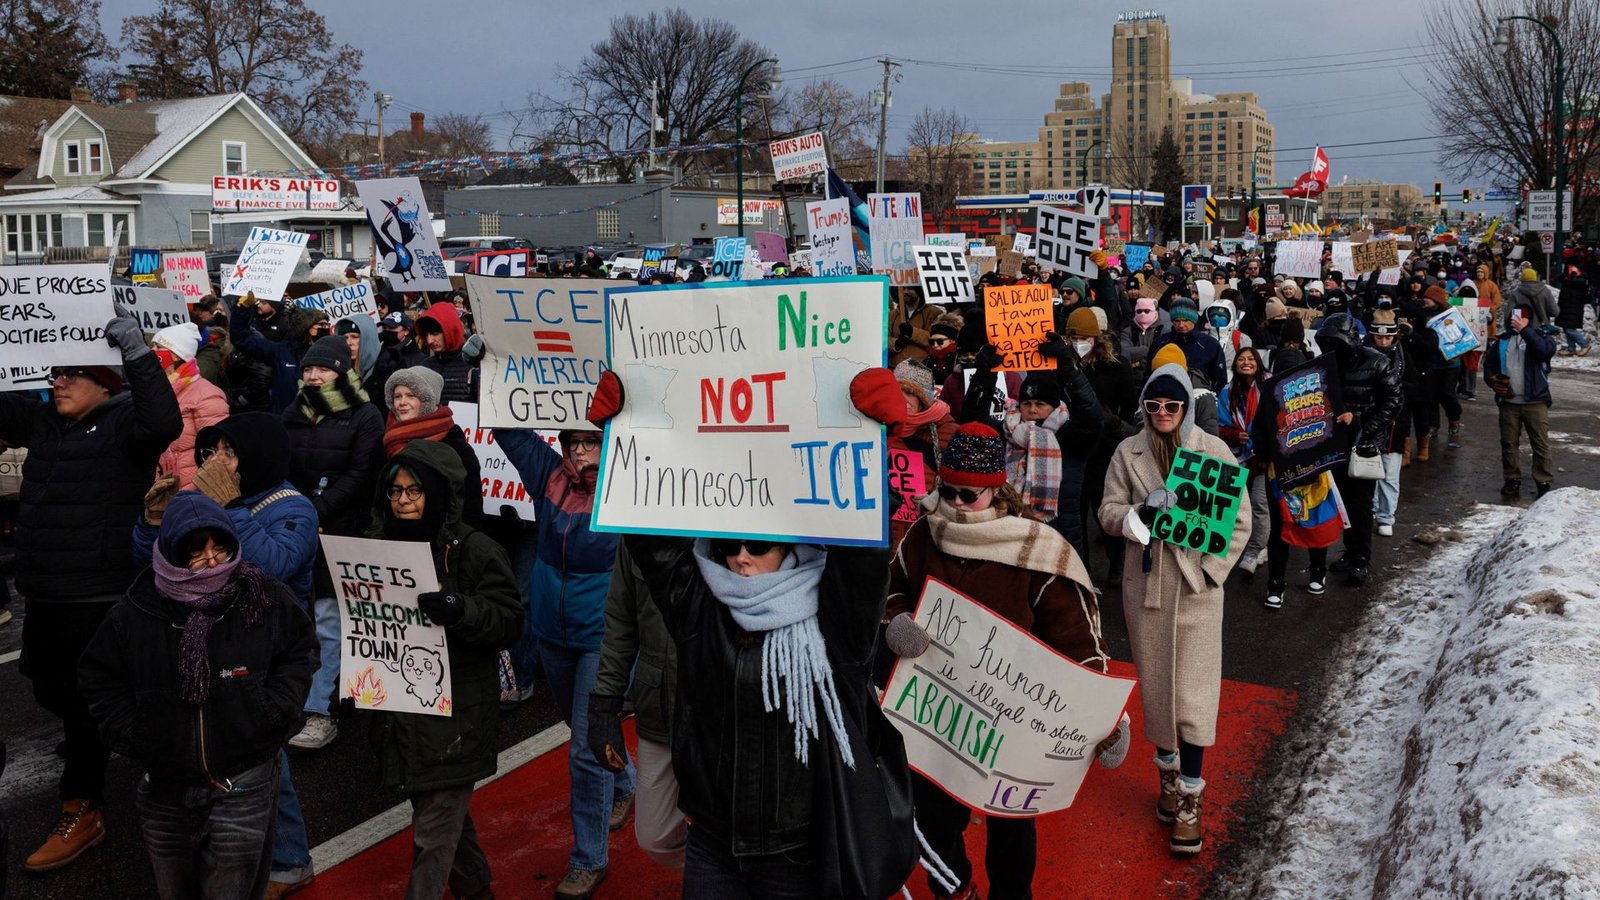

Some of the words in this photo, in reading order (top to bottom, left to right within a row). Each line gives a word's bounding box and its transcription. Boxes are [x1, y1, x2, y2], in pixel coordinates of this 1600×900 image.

[1118, 9, 1158, 20] MIDTOWN
[771, 139, 798, 157] ERIK'S
[800, 133, 822, 150] AUTO
[214, 177, 280, 191] ERIK'S
[287, 179, 337, 192] AUTO
[285, 201, 338, 209] EVEYONE
[744, 202, 761, 212] NOW
[1043, 193, 1070, 201] ARCO
[810, 206, 849, 229] Trump's
[1040, 211, 1095, 247] ICE
[714, 238, 746, 261] ICE
[813, 234, 840, 248] Gestapo
[1354, 243, 1371, 255] ICE
[1375, 239, 1395, 250] ARE
[133, 253, 158, 273] MN
[166, 258, 176, 271] NO
[178, 256, 204, 271] HUMAN
[645, 249, 664, 261] MN
[883, 241, 914, 264] ICE
[918, 251, 966, 271] ICE
[1039, 238, 1090, 273] OUT
[1354, 252, 1374, 263] THE
[1375, 250, 1395, 260] REAL
[481, 253, 526, 276] ICE
[712, 260, 742, 278] OUT
[1356, 259, 1398, 271] CRIMINALS
[37, 276, 106, 295] PROCESS
[179, 273, 185, 281] IS
[925, 276, 970, 298] OUT
[114, 287, 136, 305] NO
[296, 293, 325, 309] MN
[332, 284, 367, 304] COLD
[496, 289, 603, 324] ICE
[989, 290, 1009, 307] SAL
[1011, 290, 1023, 305] DE
[1025, 288, 1049, 304] AQUI
[611, 298, 747, 359] Minnesota
[777, 291, 851, 351] Nice
[999, 308, 1045, 320] tawm
[700, 371, 786, 424] NOT
[1283, 373, 1320, 402] ICE
[1285, 391, 1324, 412] TEARS
[485, 457, 507, 470] not
[604, 435, 774, 508] Minnesota
[791, 441, 876, 511] ICE
[1173, 450, 1242, 498] ICE
[1174, 482, 1232, 521] OUT
[1185, 513, 1208, 529] FOR
[1155, 513, 1226, 553] GOOD
[336, 562, 383, 584] ICE
[386, 567, 416, 588] IS
[341, 581, 384, 602] NOT
[345, 598, 432, 627] WELCOME
[350, 617, 377, 637] IN
[383, 623, 407, 640] MY
[347, 636, 398, 661] TOWN
[926, 598, 967, 646] No
[970, 626, 1067, 713] human
[937, 660, 958, 681] is
[966, 680, 1024, 727] illegal
[1030, 717, 1047, 733] on
[1049, 725, 1088, 744] stolen
[895, 675, 1004, 769] ABOLISH
[1051, 743, 1086, 757] land
[989, 779, 1048, 810] ICE
